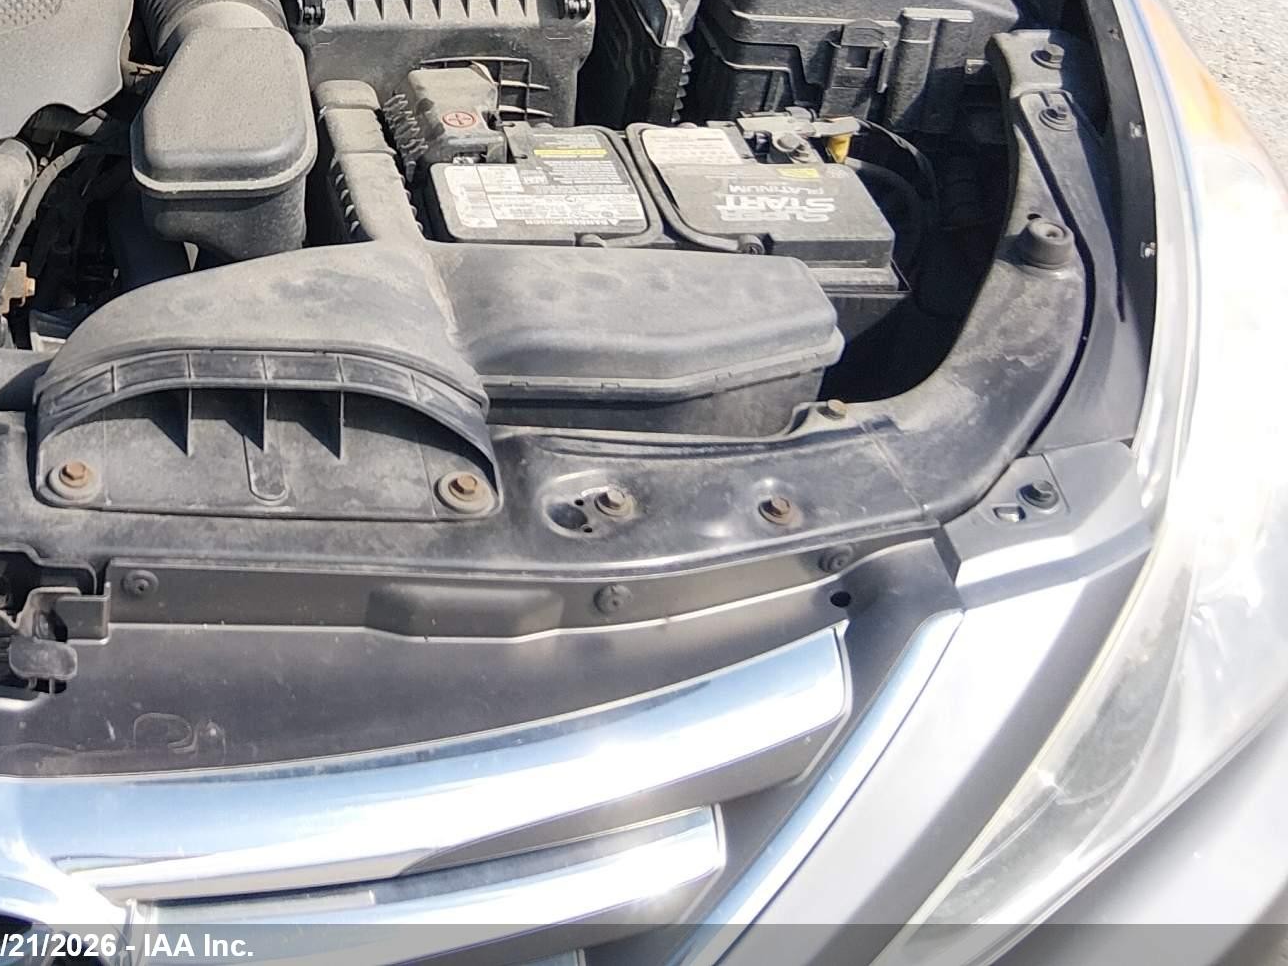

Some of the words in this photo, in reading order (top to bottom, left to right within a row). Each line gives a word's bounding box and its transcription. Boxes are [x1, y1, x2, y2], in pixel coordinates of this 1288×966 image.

[728, 184, 824, 195] PLATINUM
[714, 195, 835, 213] START
[720, 209, 830, 222] SUPER
